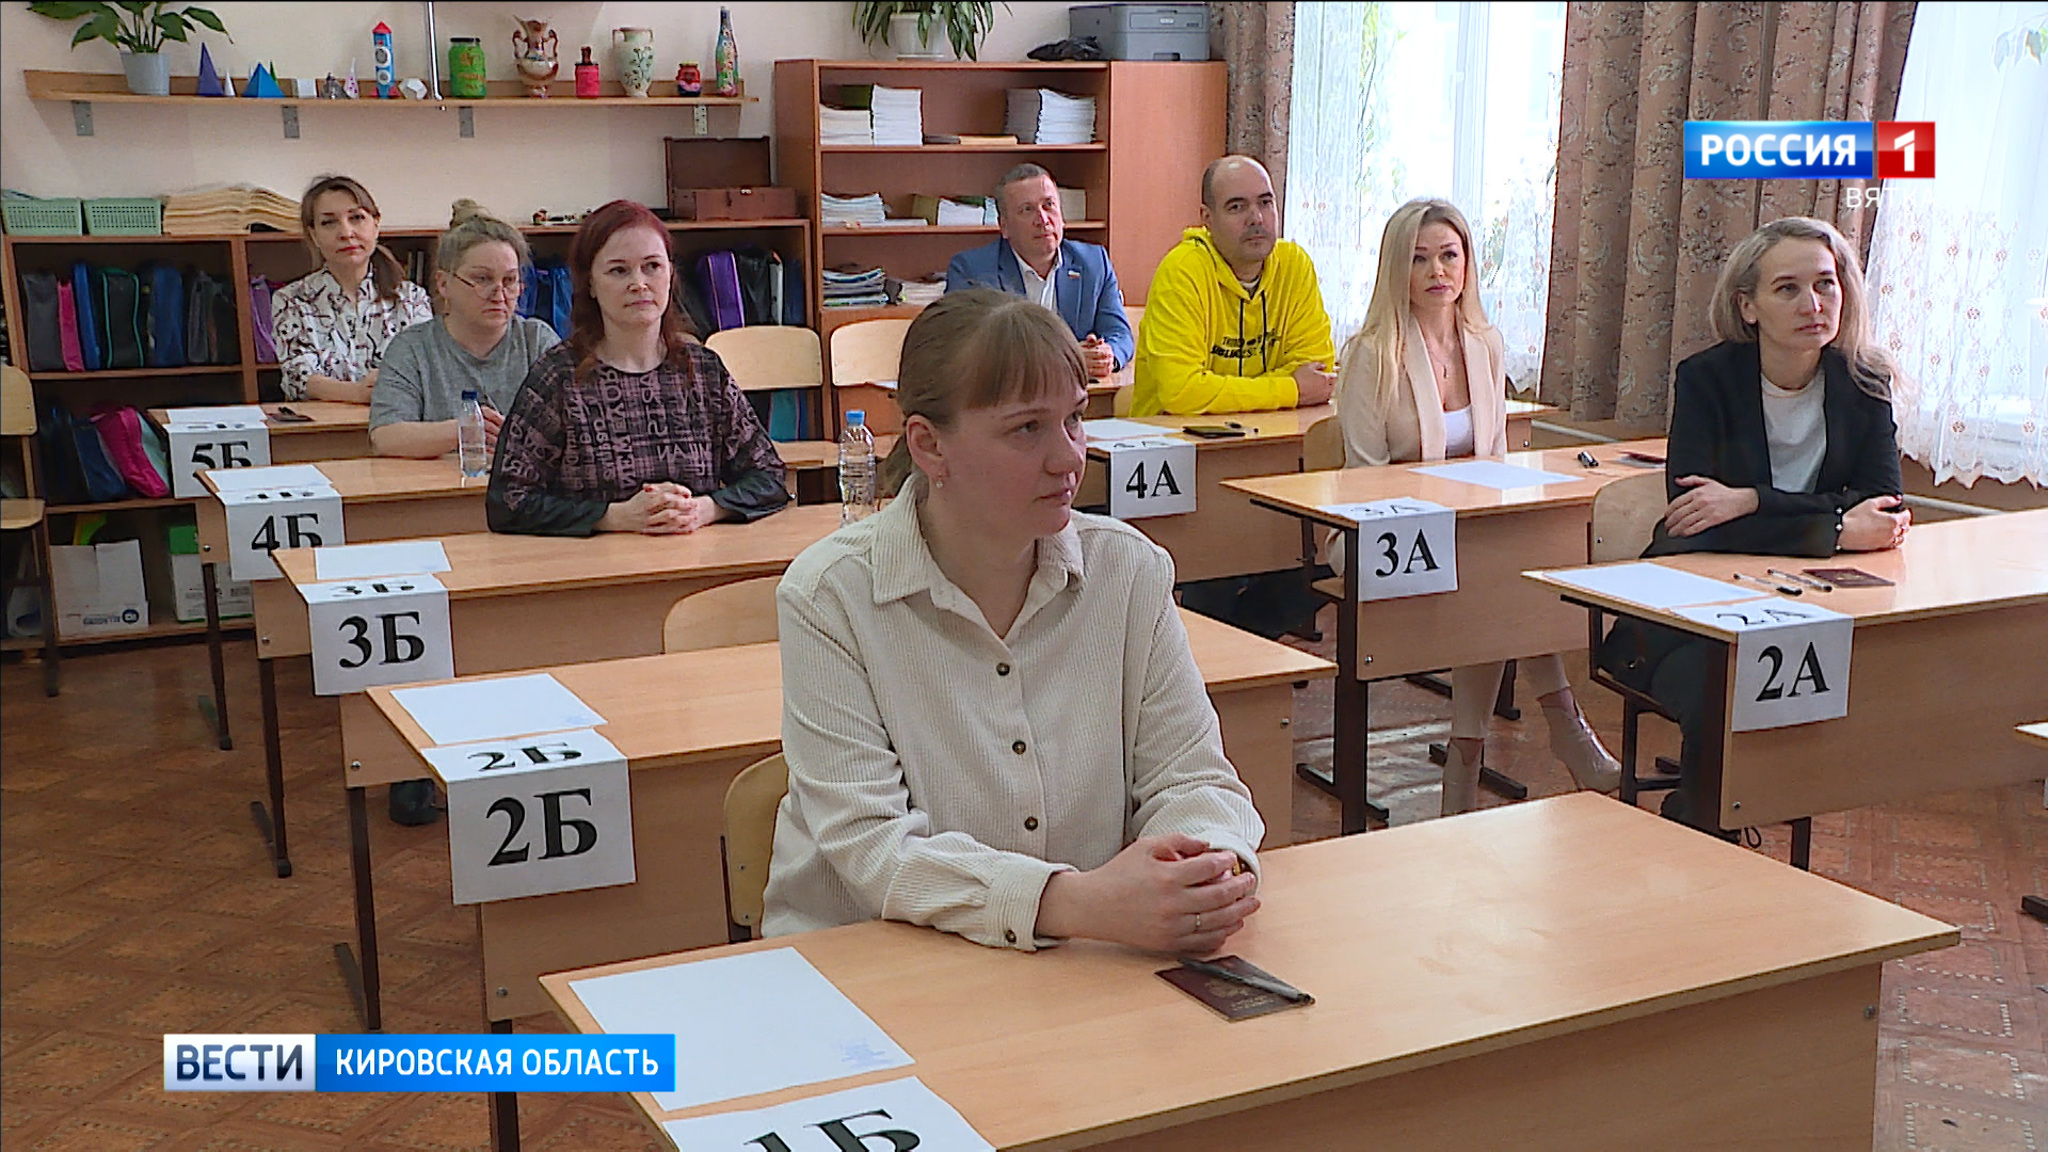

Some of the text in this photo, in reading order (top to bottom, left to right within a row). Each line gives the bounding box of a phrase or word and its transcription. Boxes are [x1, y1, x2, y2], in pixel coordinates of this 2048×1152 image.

[191, 440, 252, 473] 5Б
[1126, 458, 1182, 499] 4А
[251, 513, 322, 556] 4Б
[1375, 528, 1440, 577] 3А
[338, 611, 425, 669] 3Б
[1755, 641, 1831, 702] 2А
[467, 742, 582, 772] 2Б
[486, 788, 598, 868] 2Б
